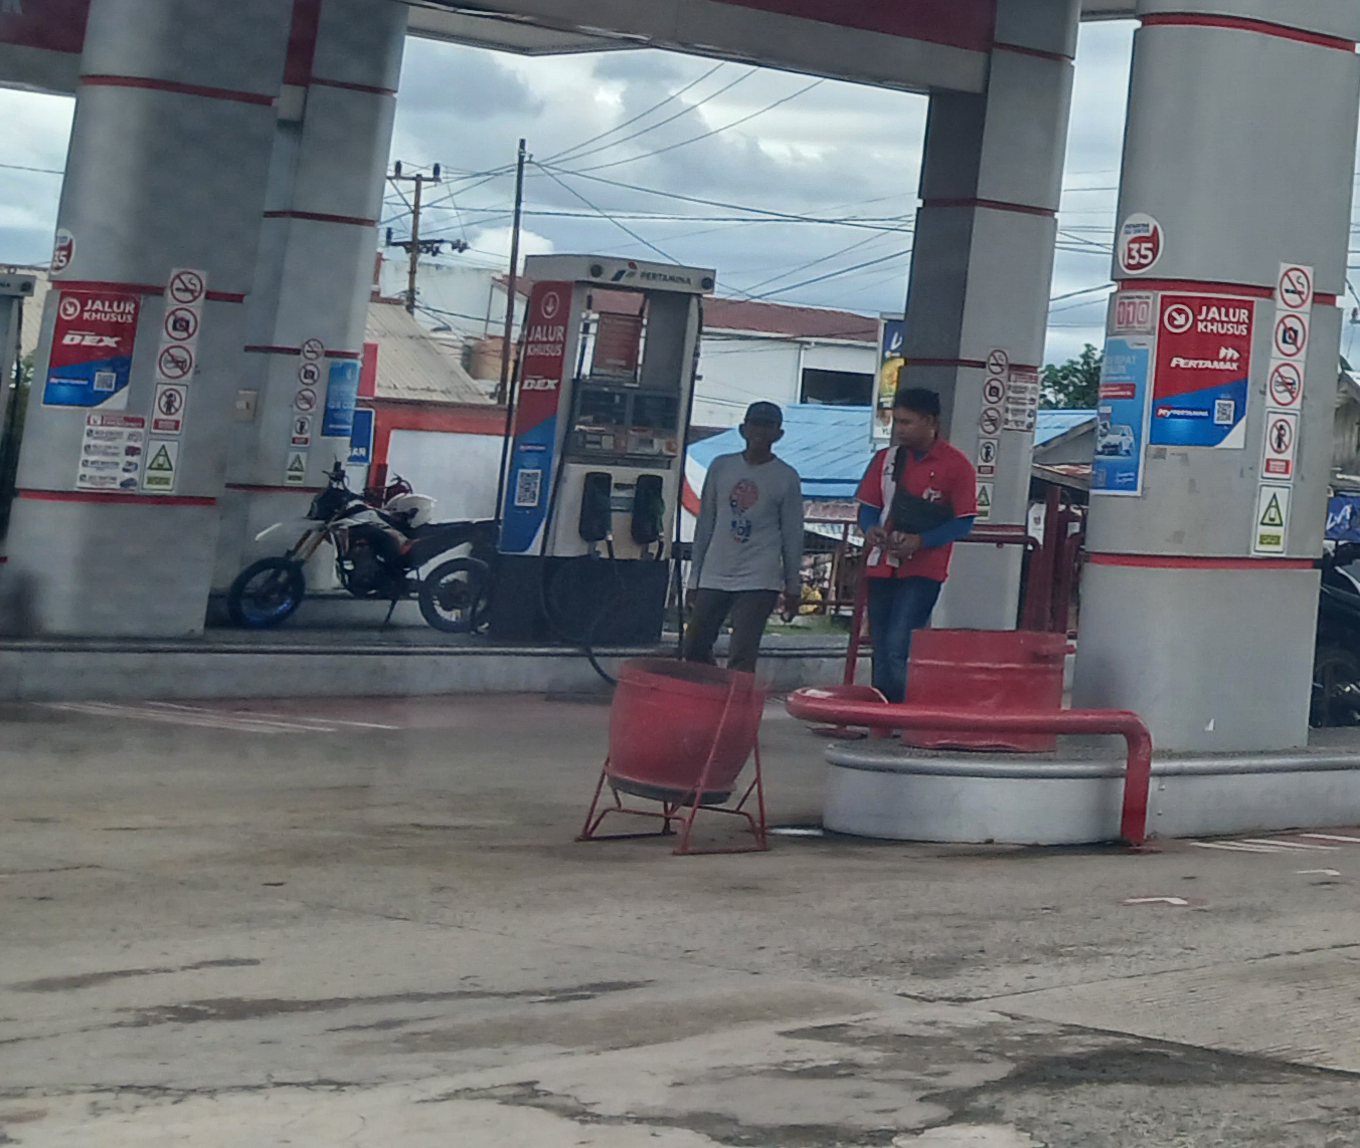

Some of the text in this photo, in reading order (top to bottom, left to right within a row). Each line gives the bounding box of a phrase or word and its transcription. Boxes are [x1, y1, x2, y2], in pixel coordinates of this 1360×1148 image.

[83, 299, 136, 314] JALUR
[82, 311, 134, 323] KHUSUS
[1197, 305, 1250, 324] JALUR
[528, 325, 565, 342] JALUR
[1197, 321, 1248, 336] KHUSUS
[61, 333, 121, 347] DEX
